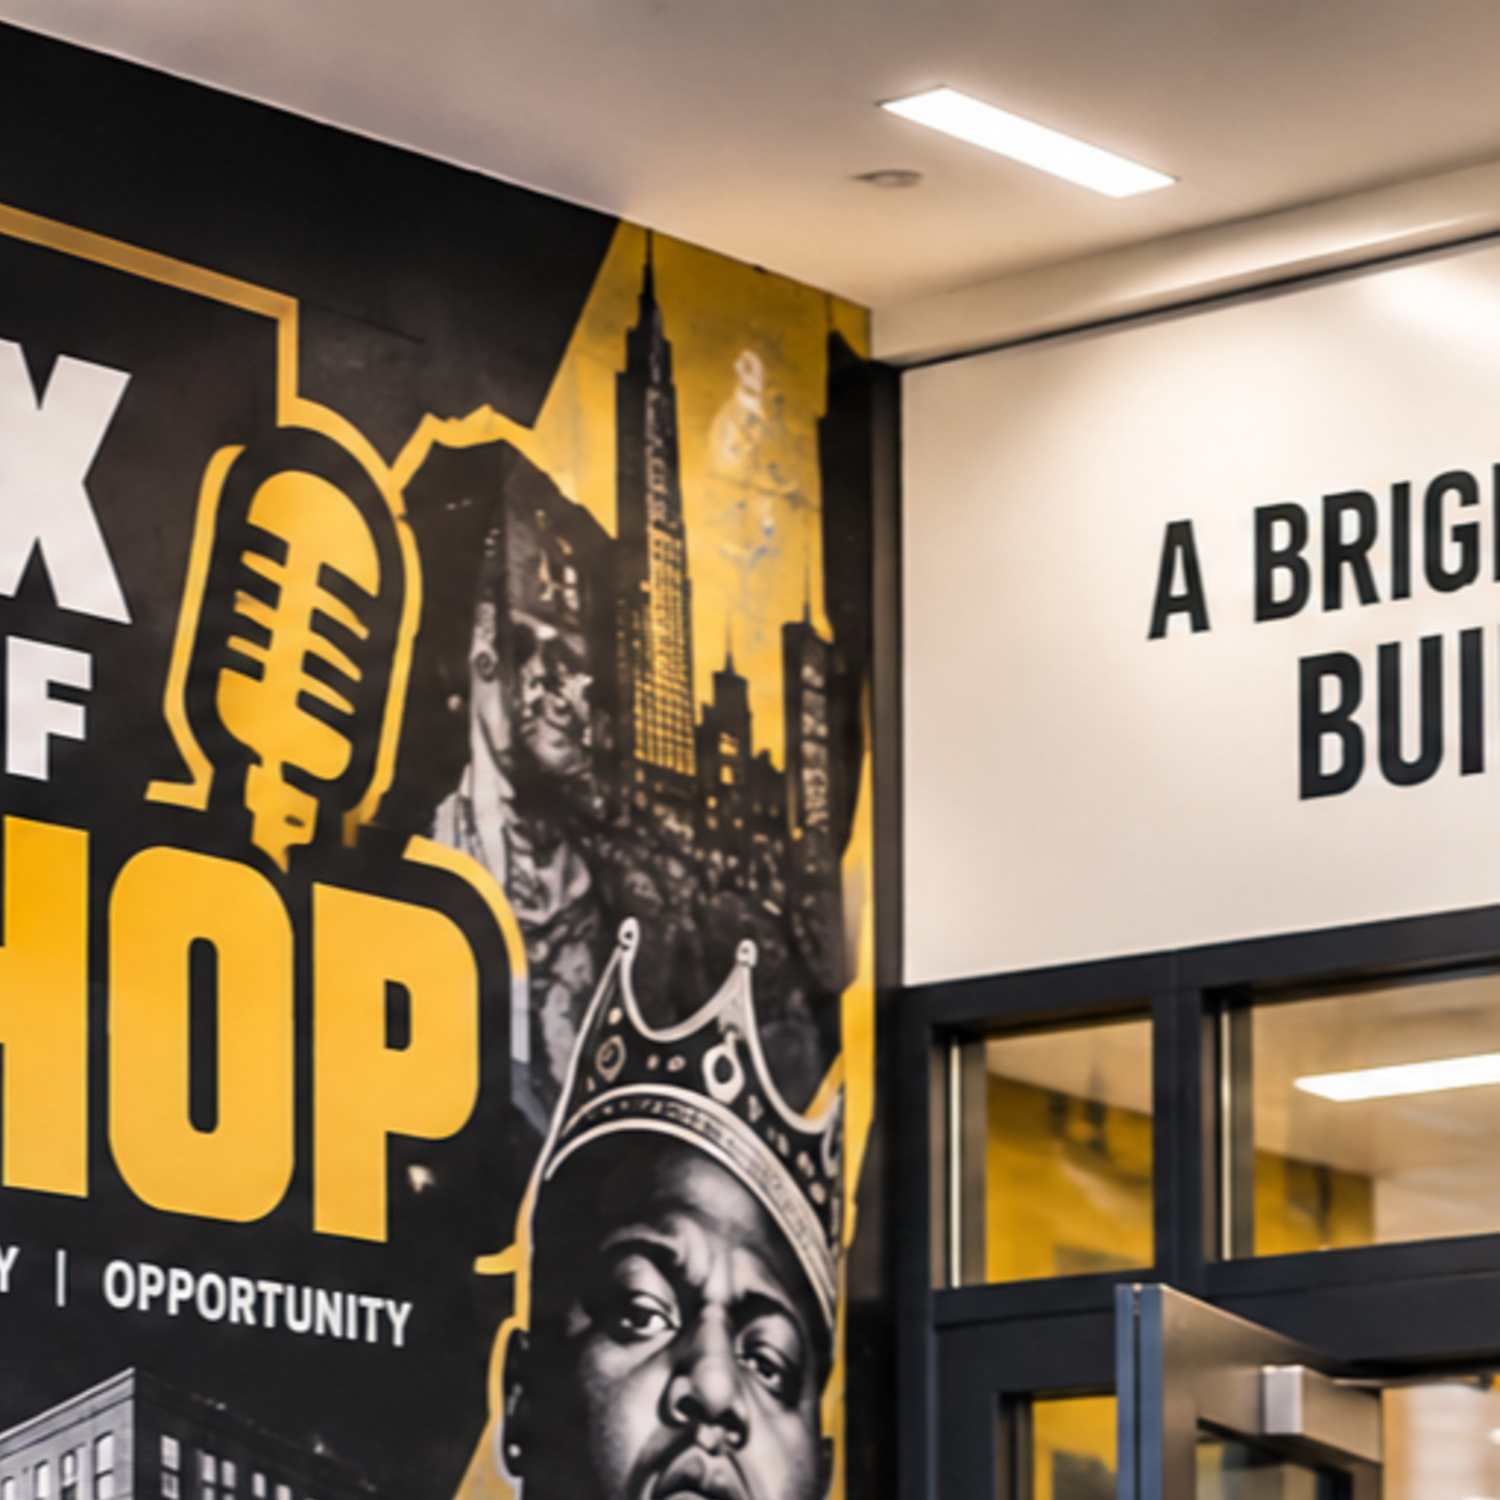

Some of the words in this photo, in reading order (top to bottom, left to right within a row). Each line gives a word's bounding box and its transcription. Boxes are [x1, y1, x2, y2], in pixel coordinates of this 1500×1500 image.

[1147, 519, 1211, 641] A
[1253, 462, 1500, 623] BRIG
[1298, 627, 1500, 801] BUI
[103, 1259, 413, 1347] OPPORTUNITY
